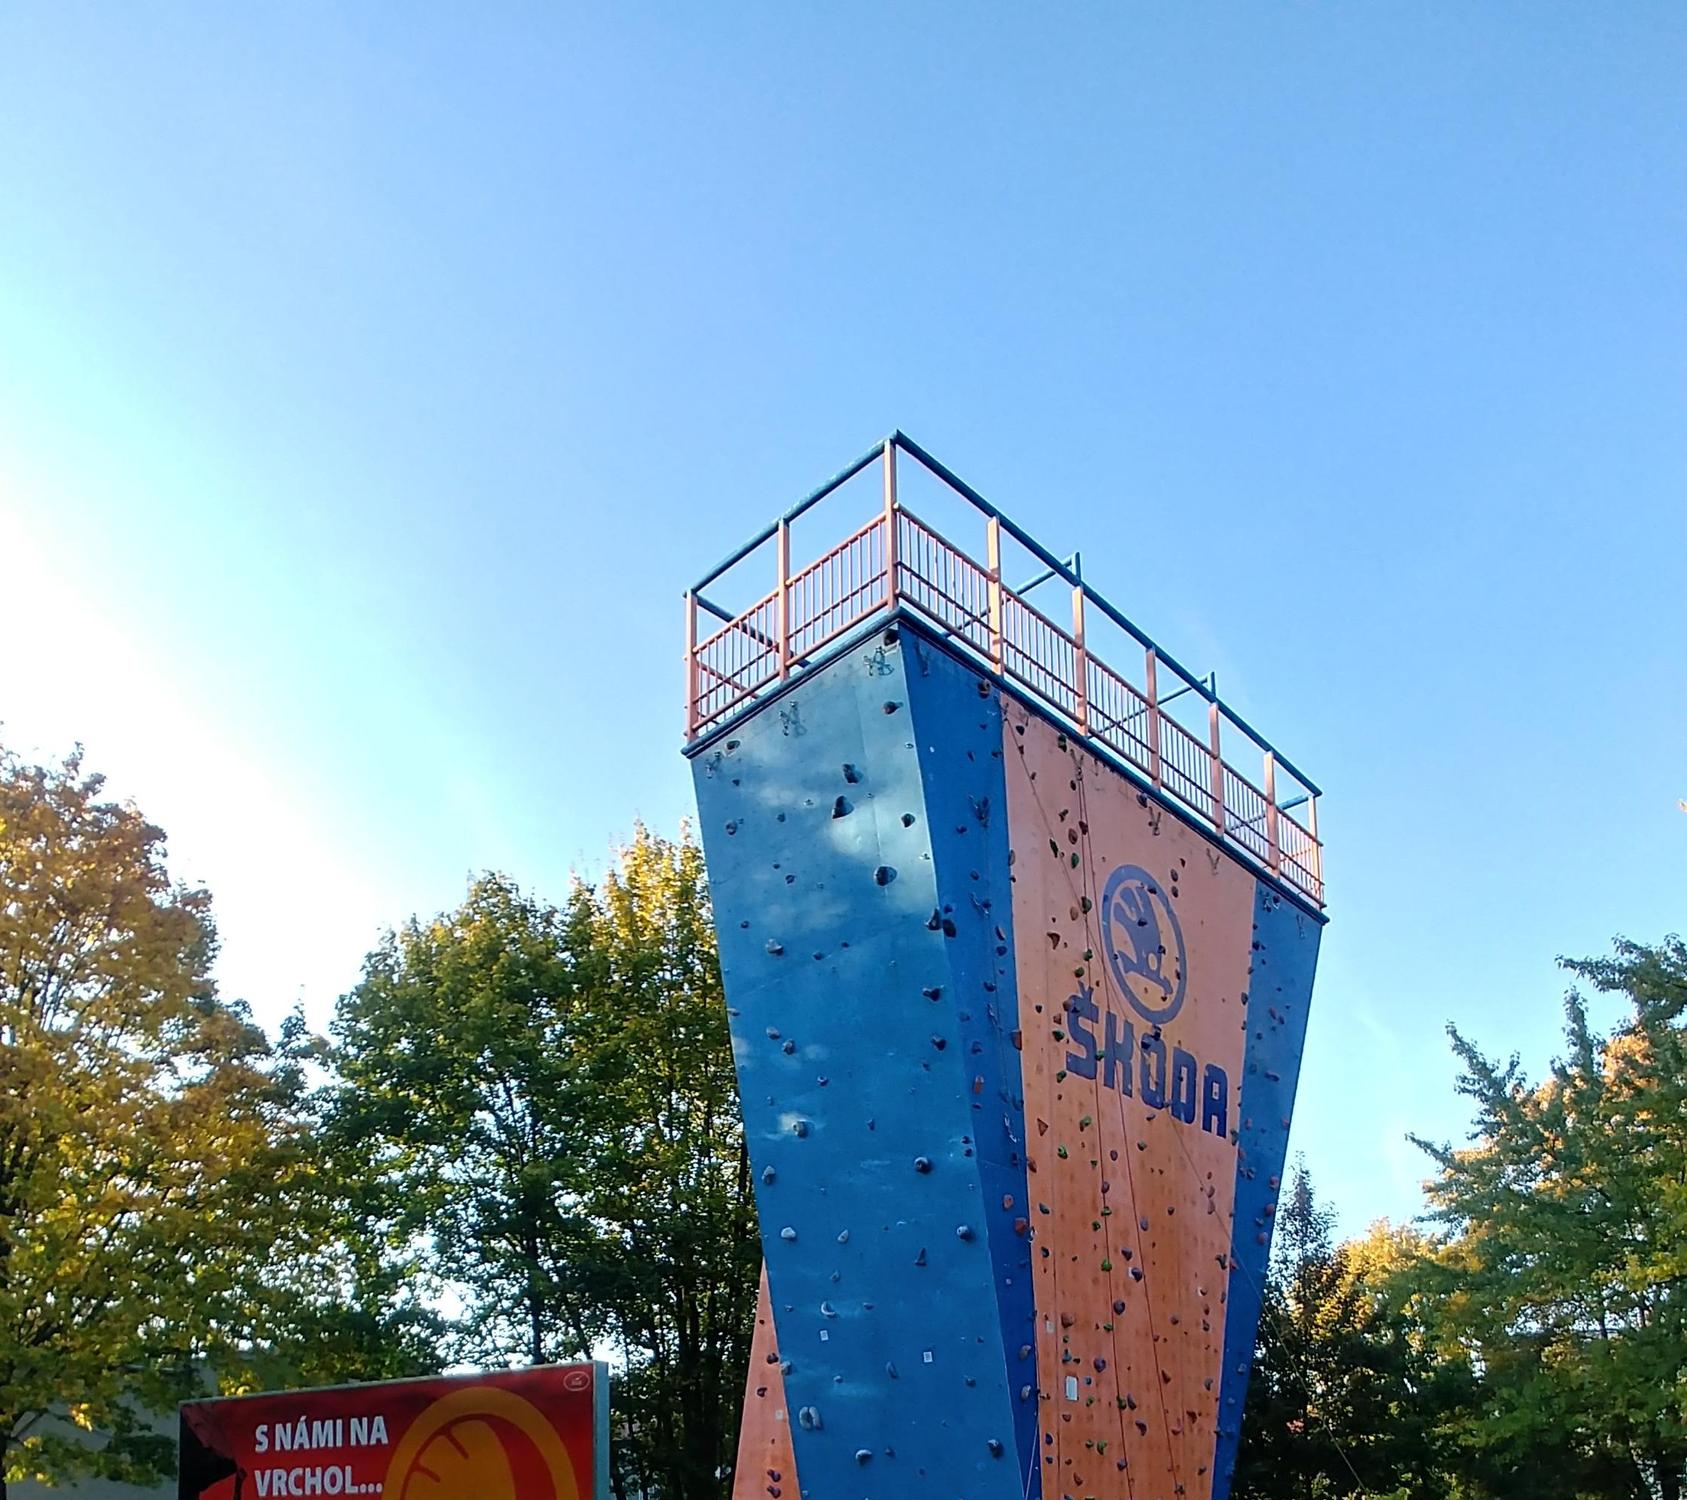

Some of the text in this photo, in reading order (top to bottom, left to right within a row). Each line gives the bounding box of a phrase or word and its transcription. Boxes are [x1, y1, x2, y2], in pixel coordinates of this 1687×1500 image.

[1066, 981, 1228, 1139] ŠKODA
[255, 1415, 389, 1453] S NÁMI NA
[254, 1465, 383, 1497] VRCHOL...
